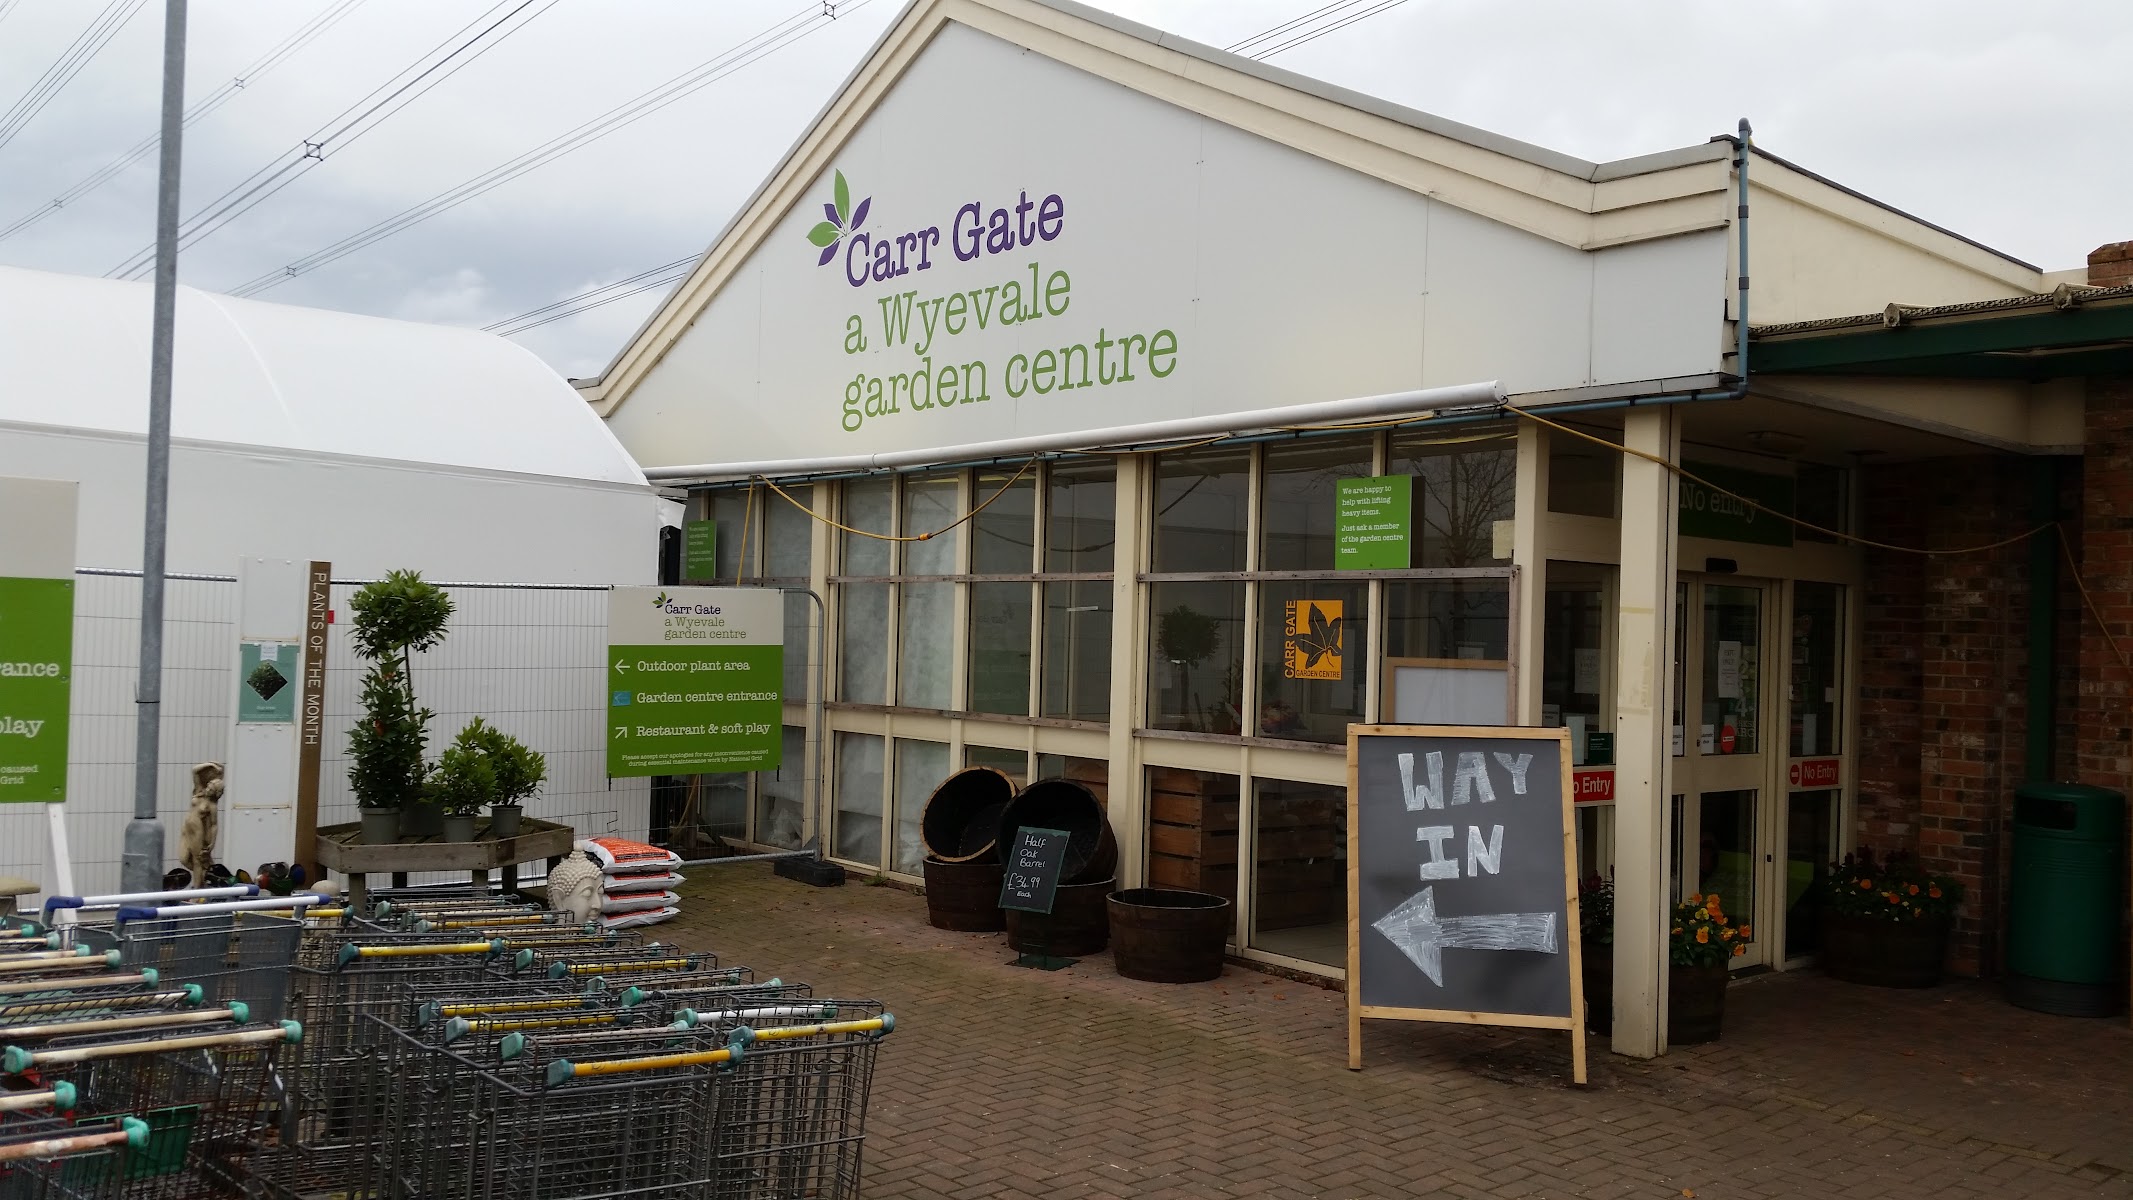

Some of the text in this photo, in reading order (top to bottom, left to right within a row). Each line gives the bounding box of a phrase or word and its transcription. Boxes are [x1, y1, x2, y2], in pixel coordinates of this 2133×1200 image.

[845, 191, 1064, 287] Carr Gate
[844, 261, 1071, 356] a Wyevale
[842, 328, 1178, 432] garden centre
[1364, 486, 1384, 494] happy
[1680, 482, 1705, 511] No
[1359, 535, 1382, 543] garden
[664, 604, 721, 615] Carr Gate
[664, 616, 725, 629] a Wyevale
[664, 627, 747, 640] garden centre
[1285, 600, 1296, 678] CARR GATE
[305, 572, 327, 745] PLANTS OF THE MONTH
[0, 663, 60, 677] ance
[637, 660, 751, 673] Outdoor plant area
[1295, 669, 1341, 678] GARDEN CENTRE
[636, 691, 778, 703] Garden centre entrance
[636, 722, 771, 737] Restaurant & soft play
[669, 752, 694, 760] apologies
[0, 765, 39, 773] caused
[1804, 764, 1837, 780] No Entry
[0, 776, 25, 785] Grid
[1398, 750, 1534, 812] WAY
[1573, 776, 1611, 795] o Entry
[1025, 835, 1047, 848] Half
[1020, 849, 1038, 858] Oak
[1416, 824, 1504, 881] IN
[1020, 858, 1046, 868] Barrel
